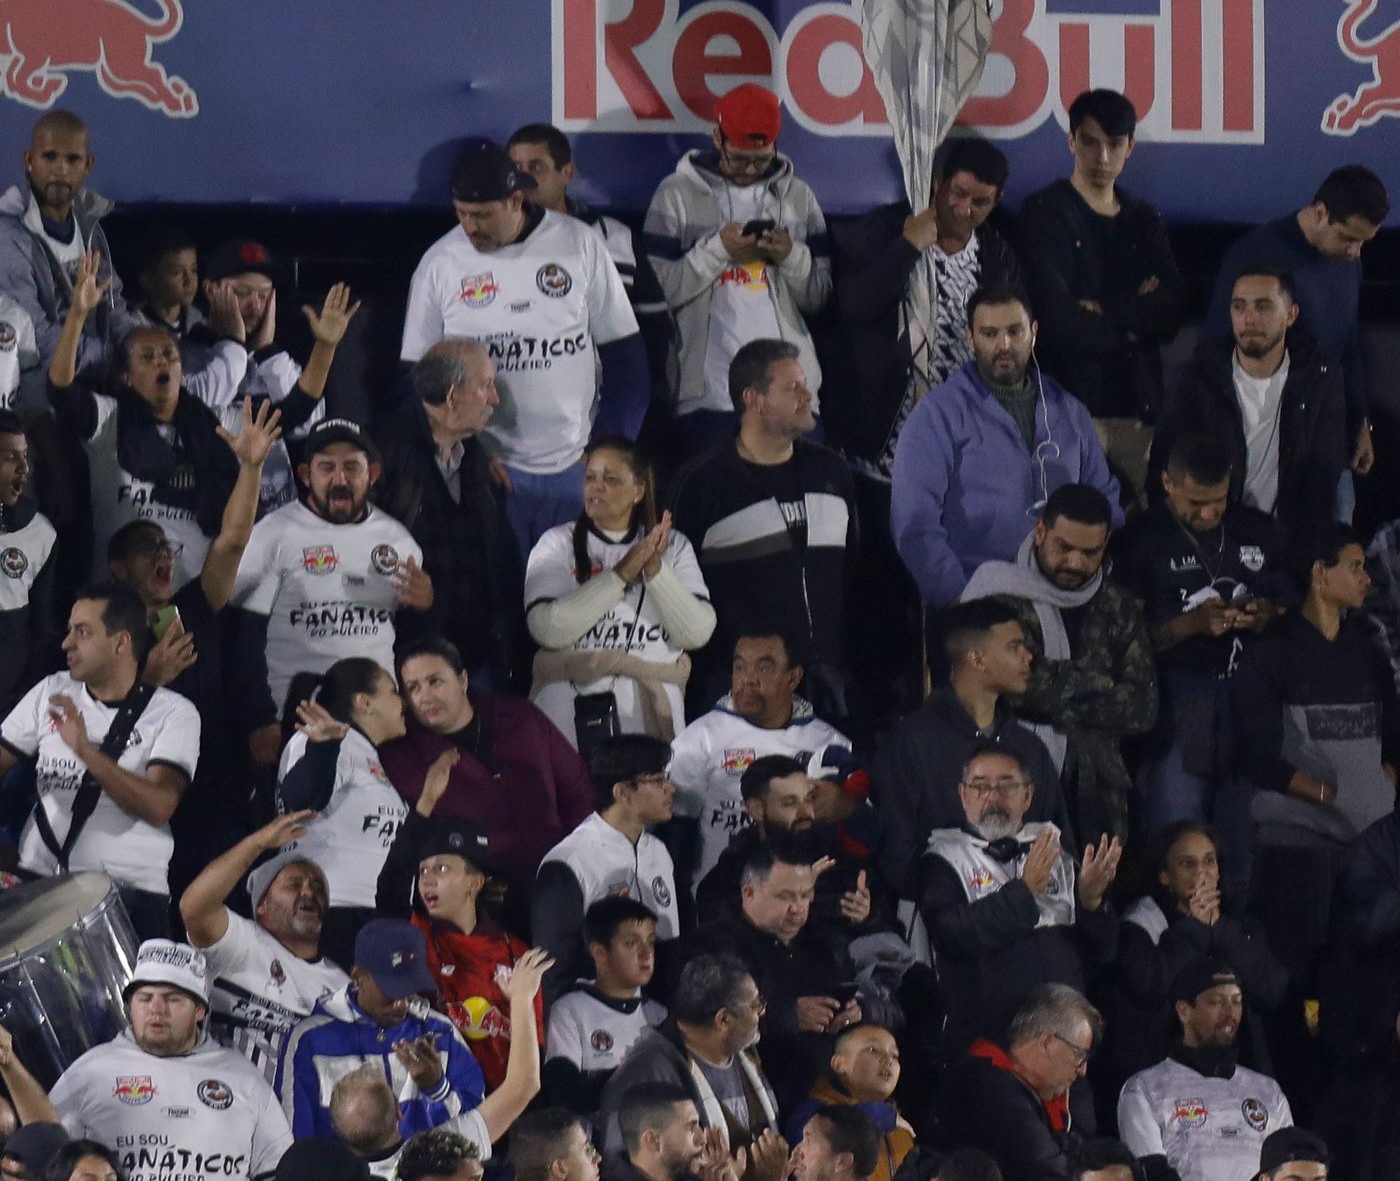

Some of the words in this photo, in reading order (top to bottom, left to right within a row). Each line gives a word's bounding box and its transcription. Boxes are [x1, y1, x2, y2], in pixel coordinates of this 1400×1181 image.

[116, 1135, 135, 1148] EU
[139, 1133, 169, 1147] SOU
[114, 1145, 246, 1176] ANÁTICOS
